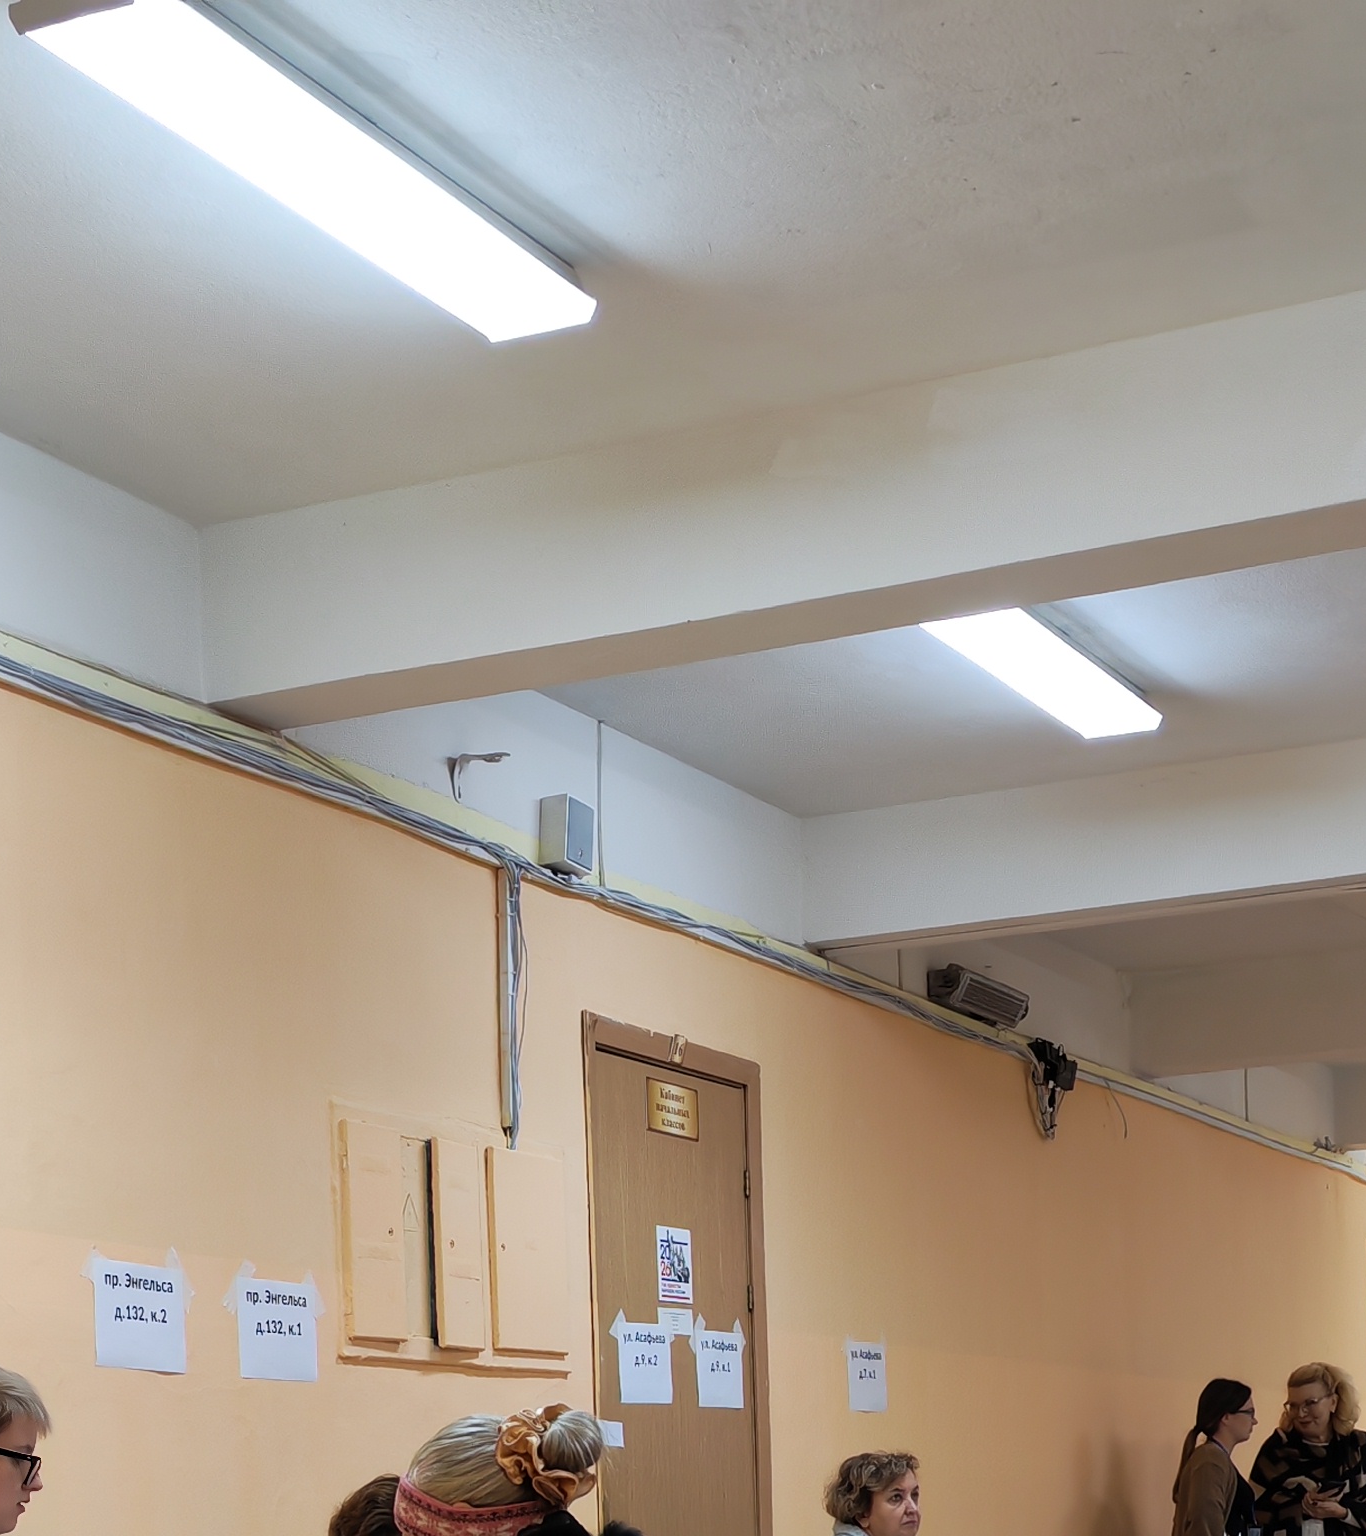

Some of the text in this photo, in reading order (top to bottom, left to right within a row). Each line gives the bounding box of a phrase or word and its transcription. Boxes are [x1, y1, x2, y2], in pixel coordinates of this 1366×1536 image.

[104, 1272, 173, 1294] пр. Энгельса
[246, 1290, 307, 1308] пр. Энгельса
[114, 1306, 167, 1324] д.132, к.2
[255, 1321, 302, 1336] д.132, к.1
[635, 1332, 665, 1345] Асафьева
[711, 1339, 738, 1352] Асафьева
